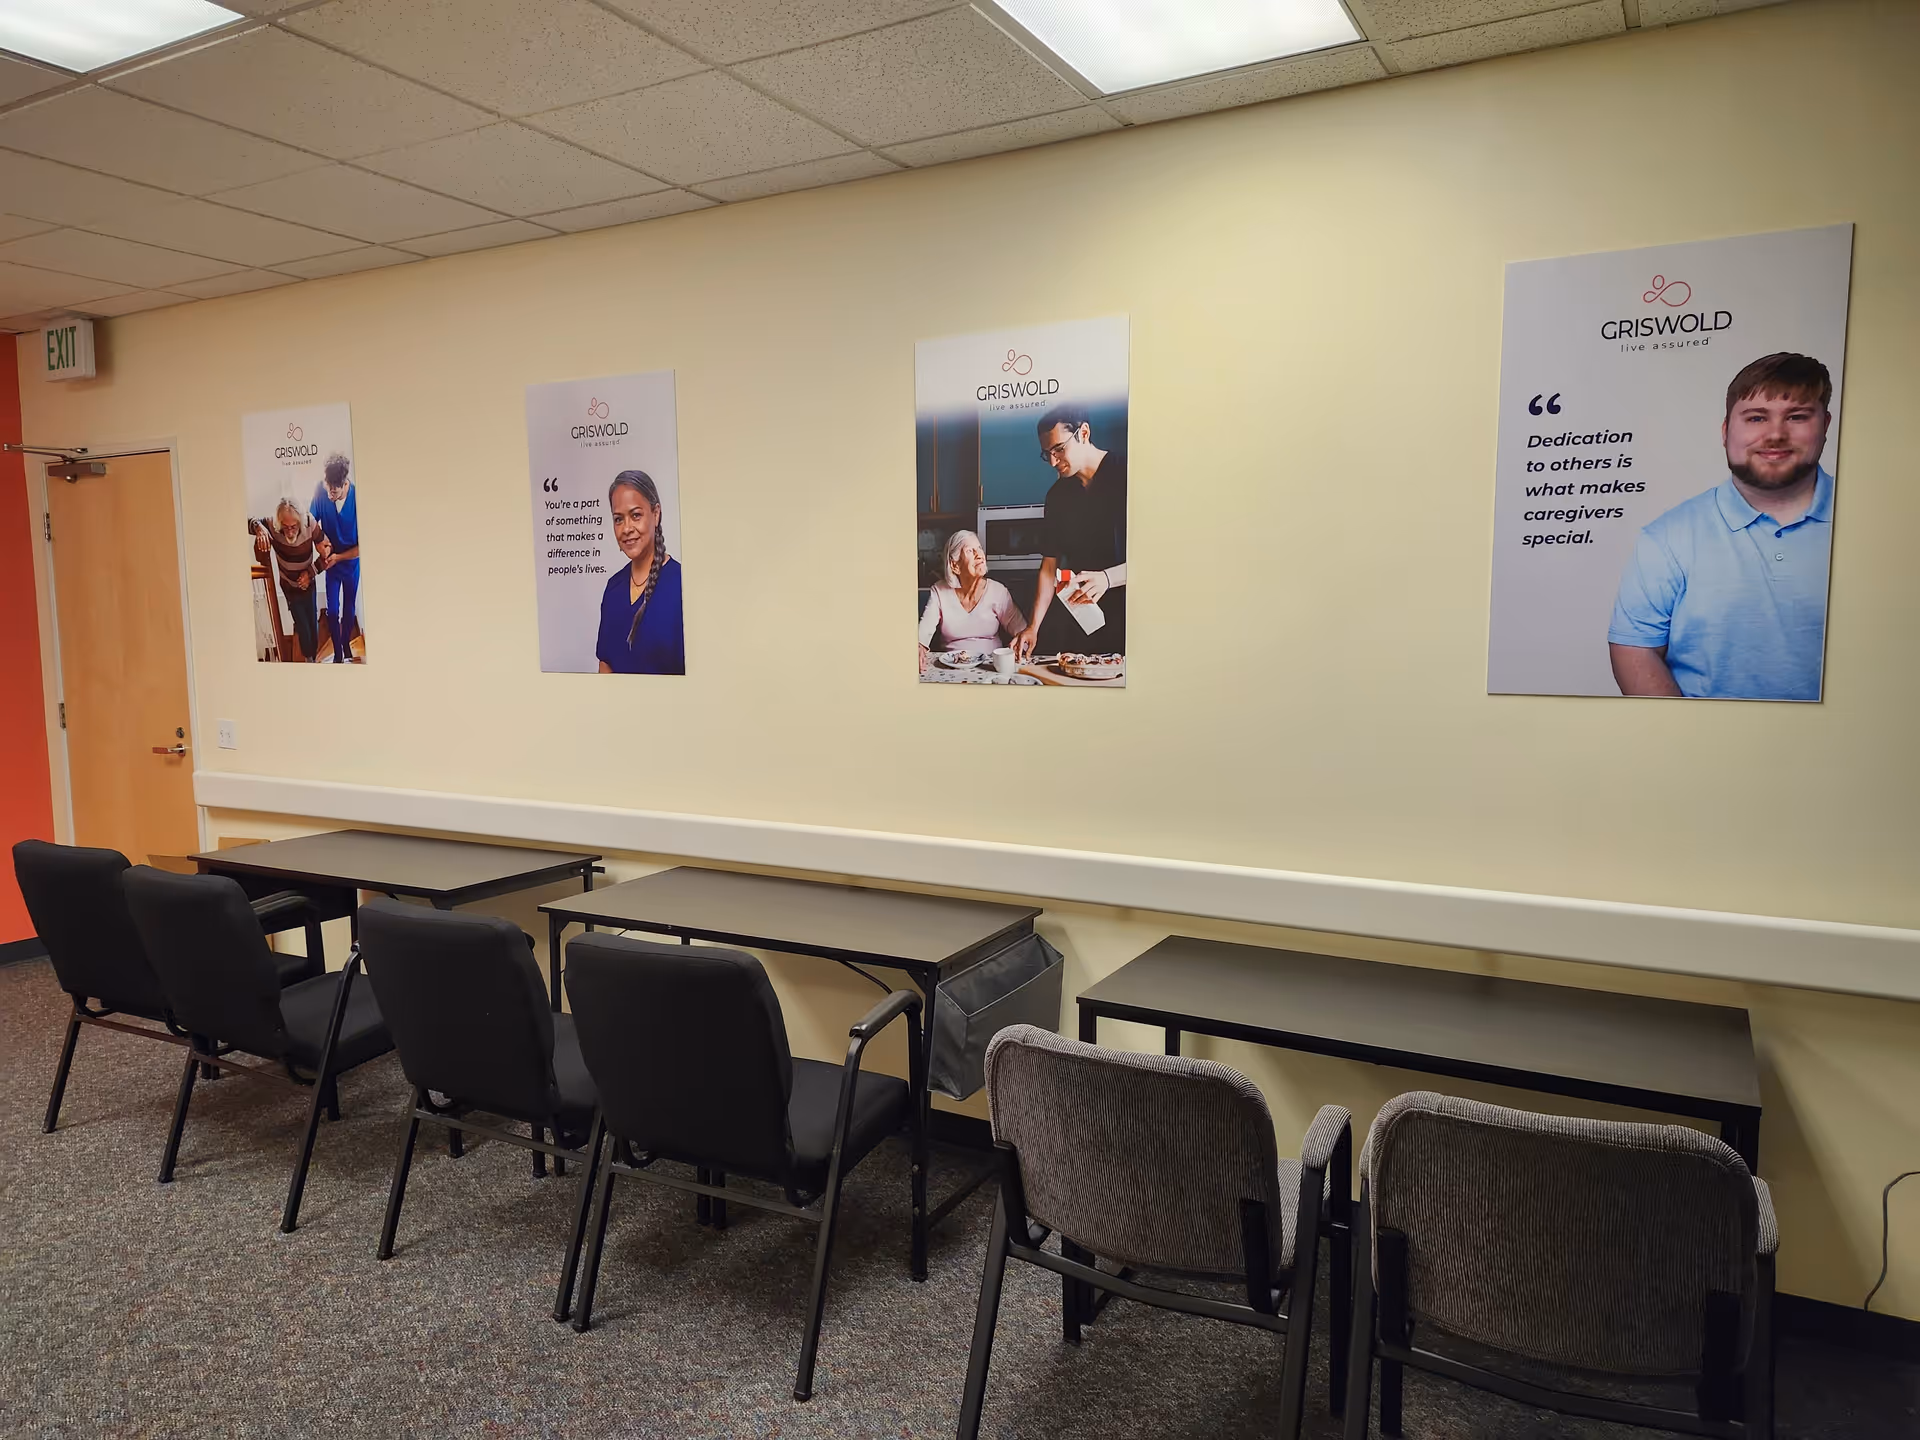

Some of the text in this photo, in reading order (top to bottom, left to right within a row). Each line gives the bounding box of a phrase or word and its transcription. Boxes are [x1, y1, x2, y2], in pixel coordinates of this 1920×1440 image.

[1601, 311, 1732, 340] GRISWOLD
[47, 326, 77, 371] EXIT
[1621, 338, 1708, 352] live assured
[977, 380, 1059, 401] GRISWOLD
[1009, 400, 1046, 410] assured
[571, 422, 628, 439] GRISWOLD
[1527, 430, 1632, 448] Dedication
[275, 444, 318, 458] GRISWOLD
[1526, 454, 1632, 472] to others is
[1525, 478, 1645, 497] what makes
[545, 499, 570, 510] You're
[580, 498, 600, 510] part
[545, 514, 602, 526] of something
[1524, 505, 1623, 524] caregivers
[547, 531, 603, 542] that makes a
[1522, 530, 1594, 548] special.
[547, 548, 600, 558] difference in
[548, 564, 606, 576] people's lives.
